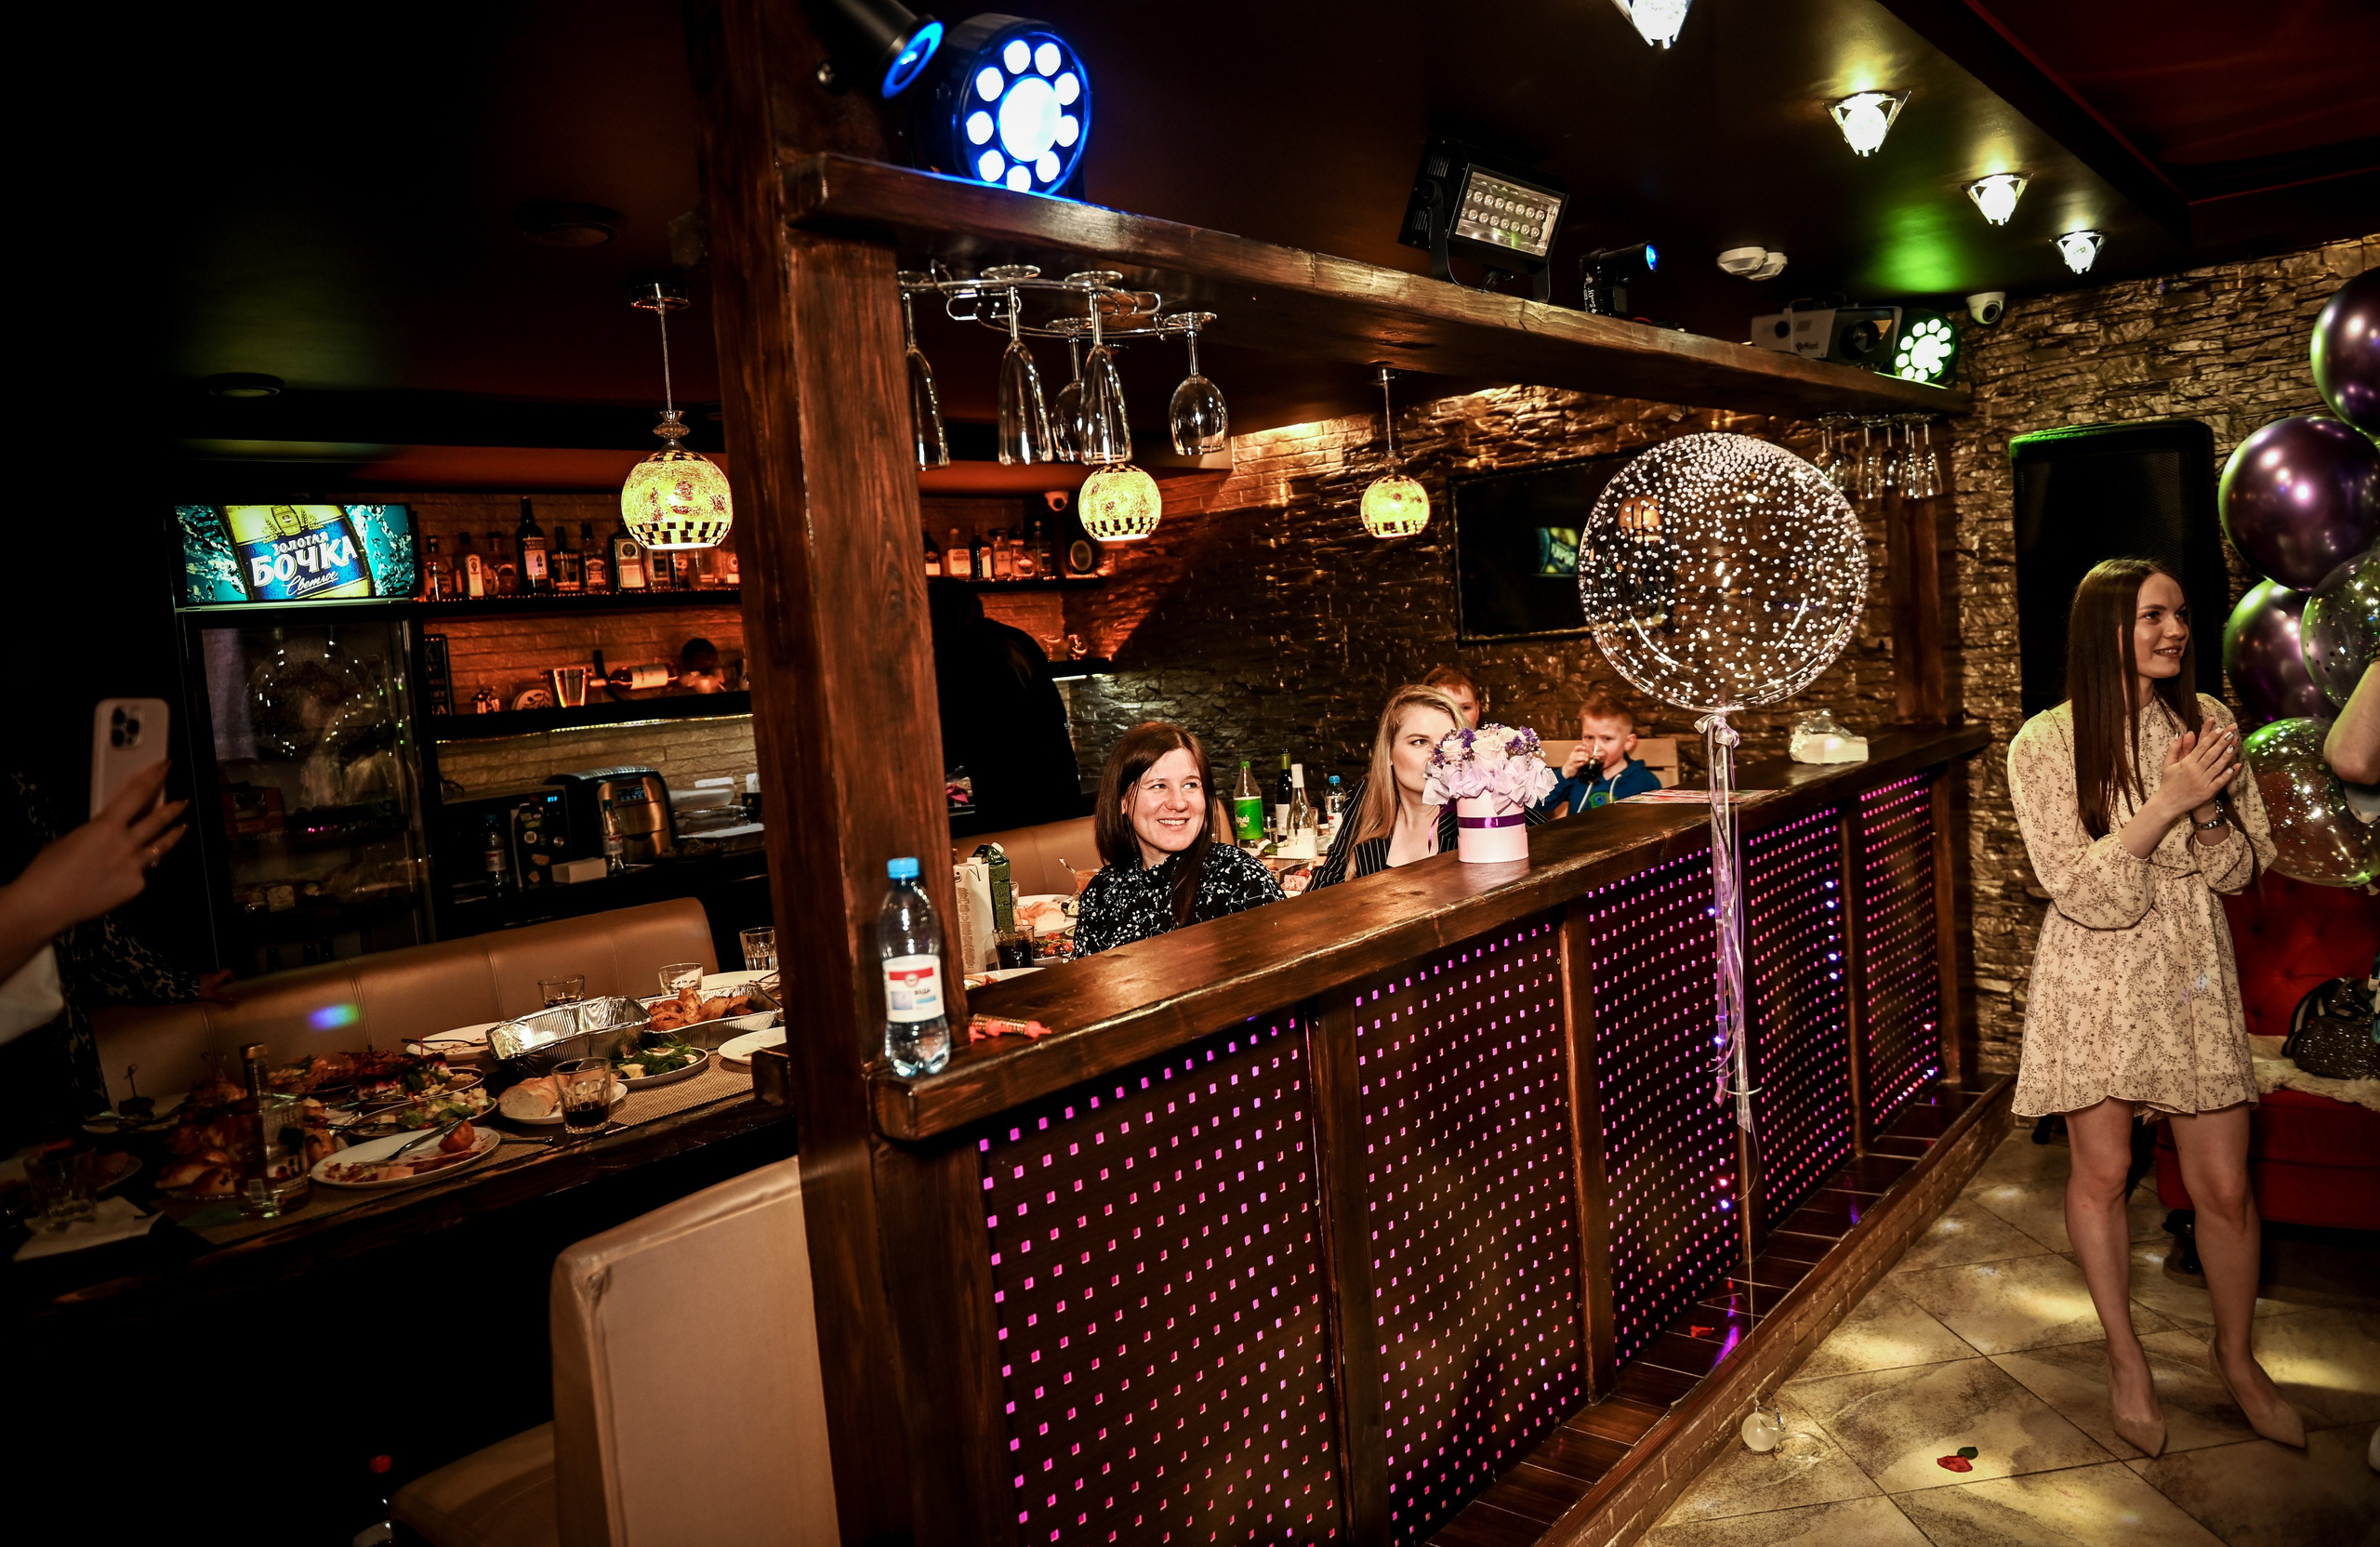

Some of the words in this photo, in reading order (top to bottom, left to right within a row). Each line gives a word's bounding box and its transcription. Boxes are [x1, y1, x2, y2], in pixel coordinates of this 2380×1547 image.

[271, 532, 329, 556] ЗОЛОТАЯ
[250, 535, 359, 588] БОЧКА
[282, 570, 340, 597] Светлое
